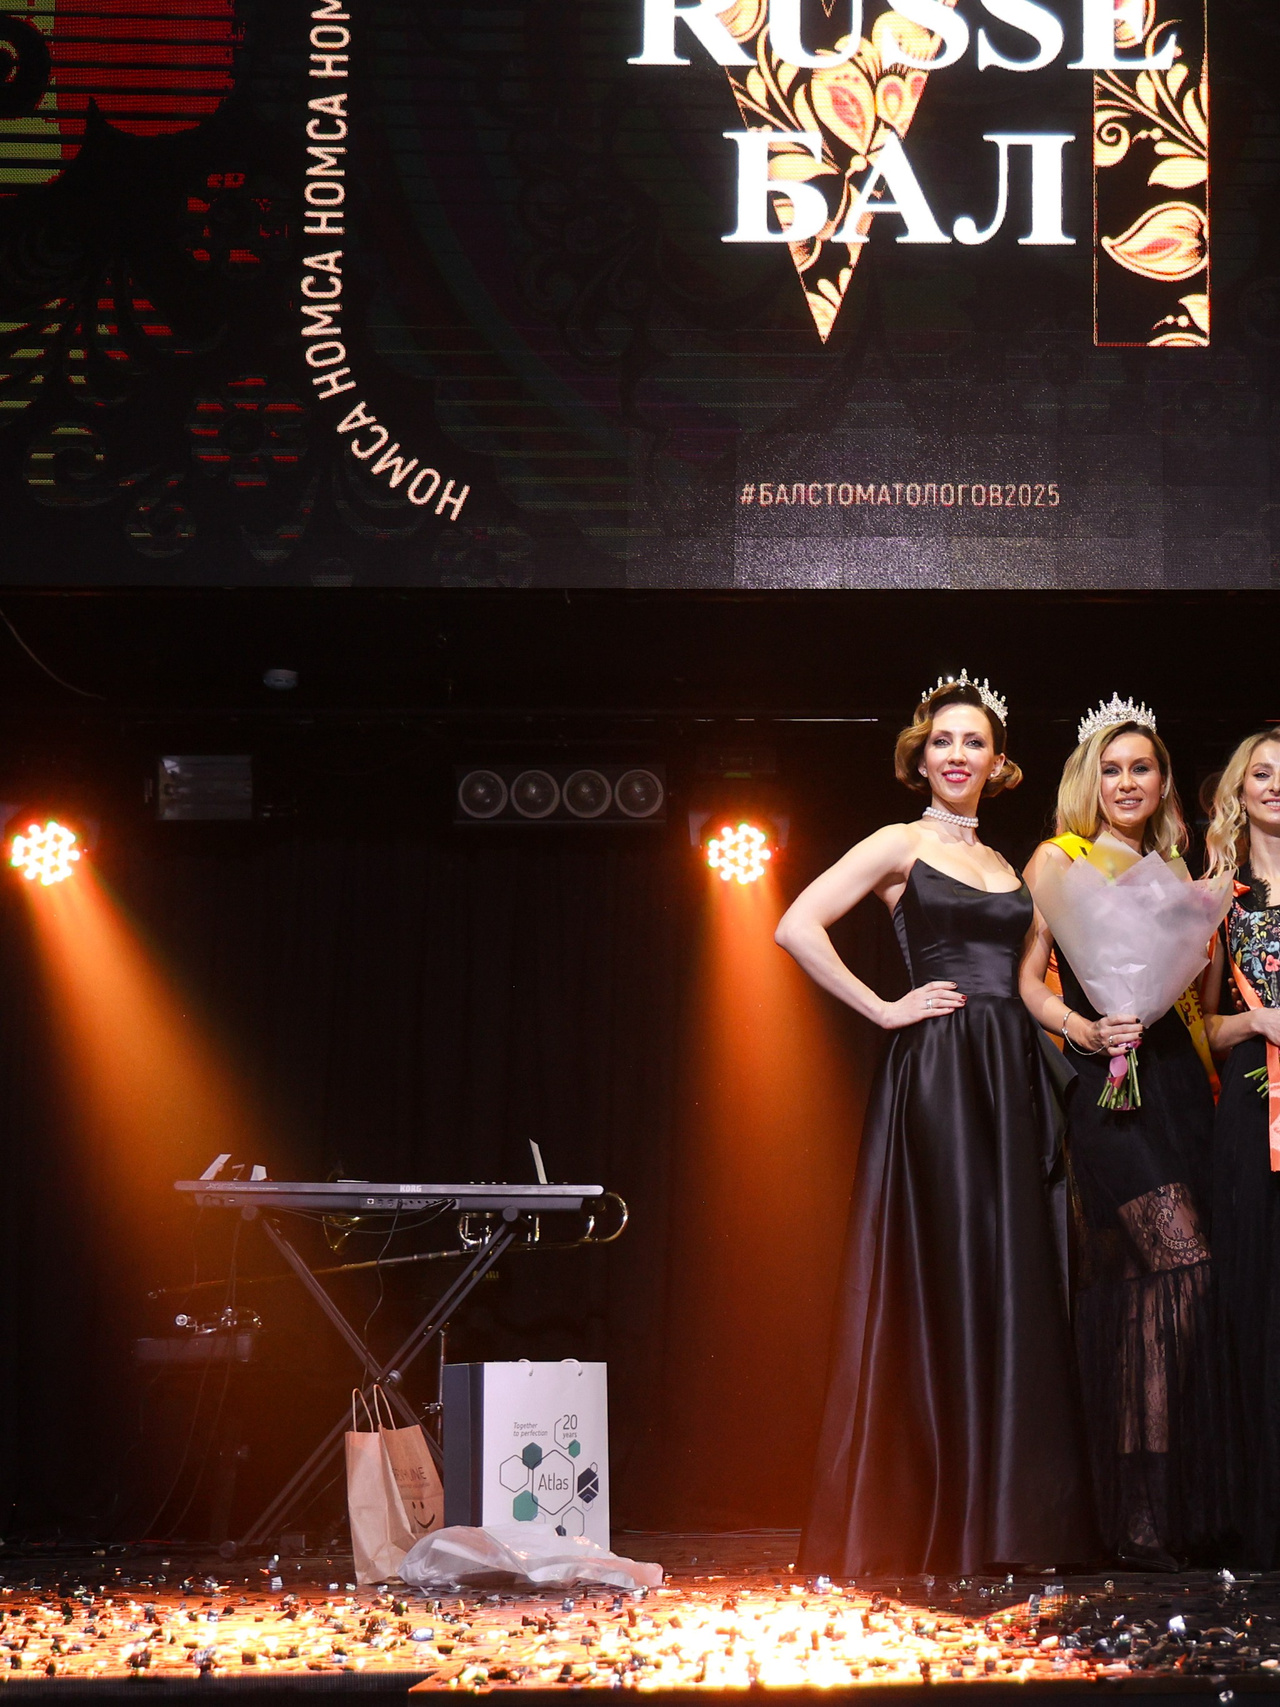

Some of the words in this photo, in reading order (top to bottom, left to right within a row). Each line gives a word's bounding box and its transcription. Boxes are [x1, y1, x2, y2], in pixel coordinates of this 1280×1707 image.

[628, 0, 1178, 71] RUSSE
[303, 93, 348, 234] НОМСА
[721, 130, 1077, 245] БАЛ
[300, 250, 357, 400] НОМСА
[336, 400, 471, 521] НОМСА
[740, 483, 1061, 507] #БАЛСТОМАТОЛОГОВ2025
[399, 1184, 422, 1193] KORG
[513, 1422, 538, 1431] Together
[562, 1414, 578, 1430] 20
[520, 1429, 548, 1438] perfection
[562, 1431, 577, 1440] years
[537, 1472, 569, 1491] Atlas
